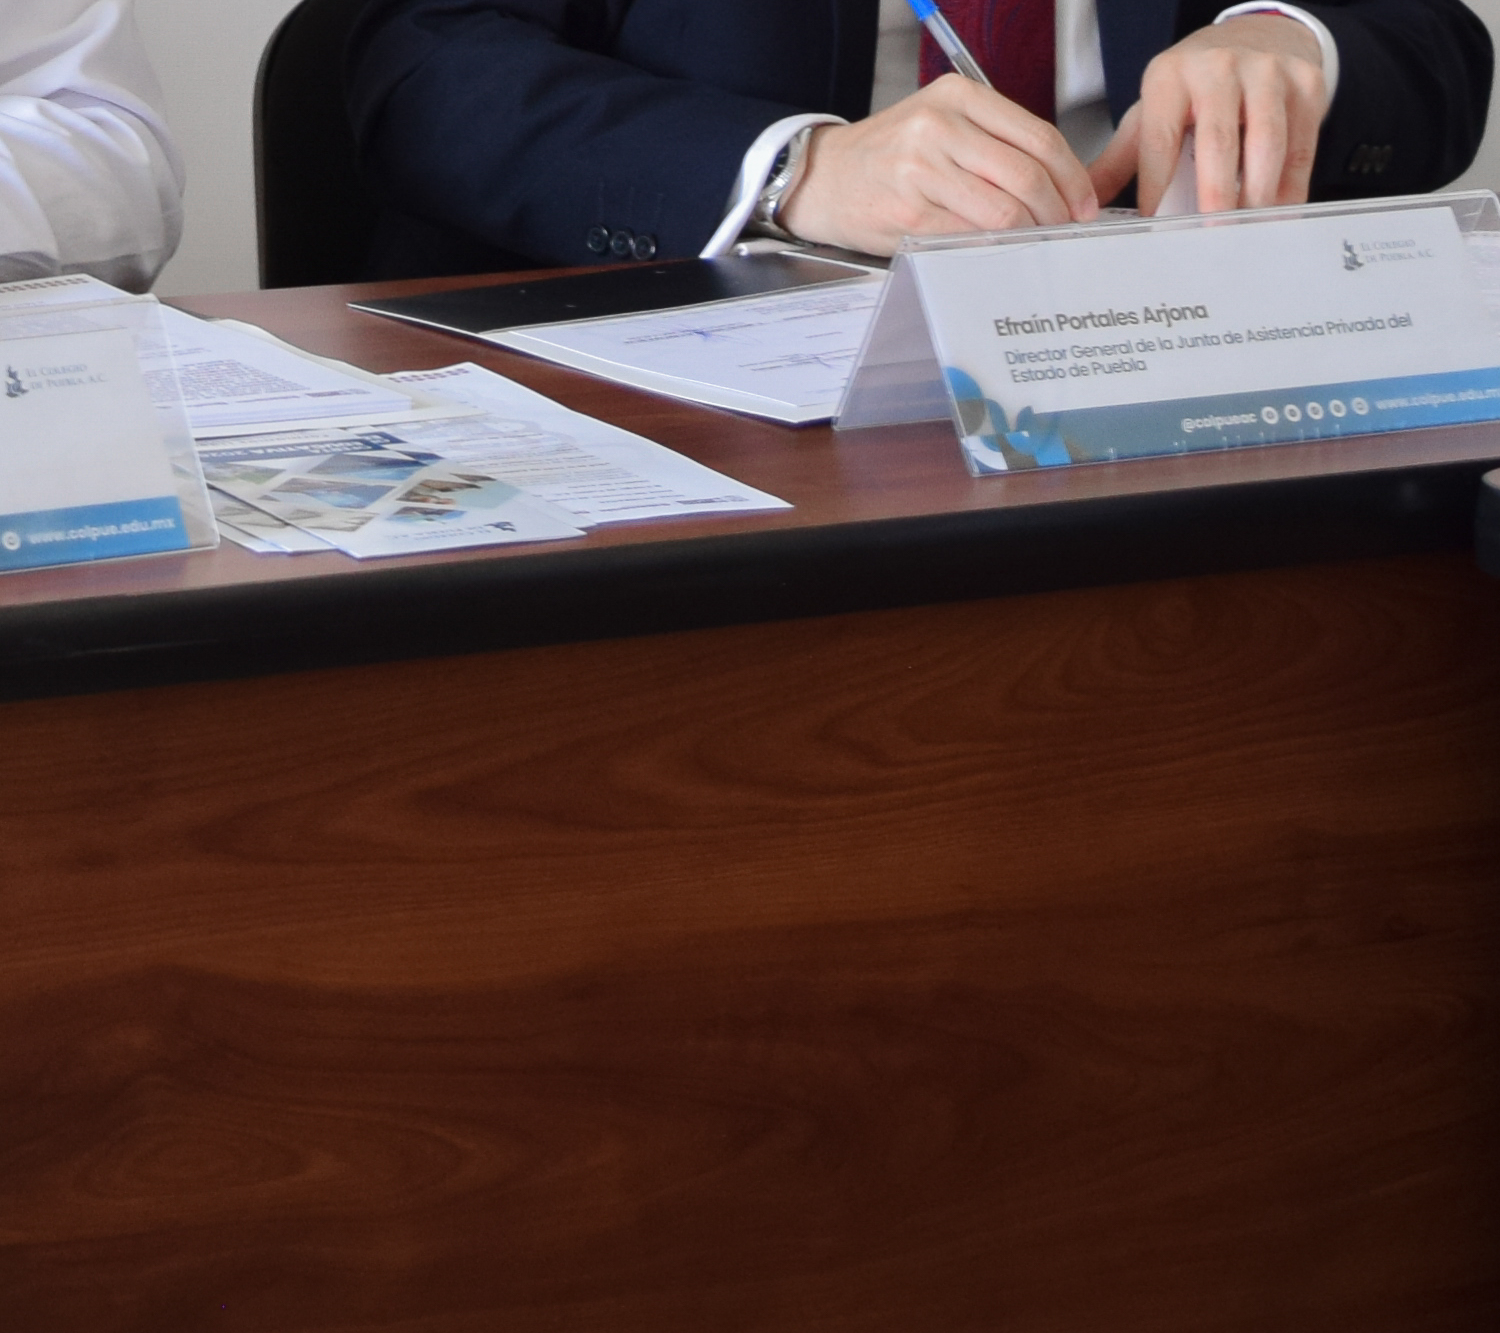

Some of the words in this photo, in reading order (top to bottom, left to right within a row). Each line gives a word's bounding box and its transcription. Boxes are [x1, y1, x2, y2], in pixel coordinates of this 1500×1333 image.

[993, 314, 1055, 336] Efraín
[1055, 309, 1139, 331] Portales
[1143, 303, 1209, 328] Arjona
[1004, 348, 1067, 365] Director
[1070, 340, 1133, 359] General
[1136, 338, 1155, 353] de
[1159, 336, 1174, 351] la
[1177, 333, 1221, 349] Junta
[1225, 331, 1244, 345] de
[1247, 324, 1325, 342] Asistencia
[1326, 316, 1386, 335] Privada
[1388, 313, 1413, 329] del
[1010, 365, 1066, 383] Estado
[1069, 363, 1089, 377] de
[1092, 358, 1148, 375] Puebla
